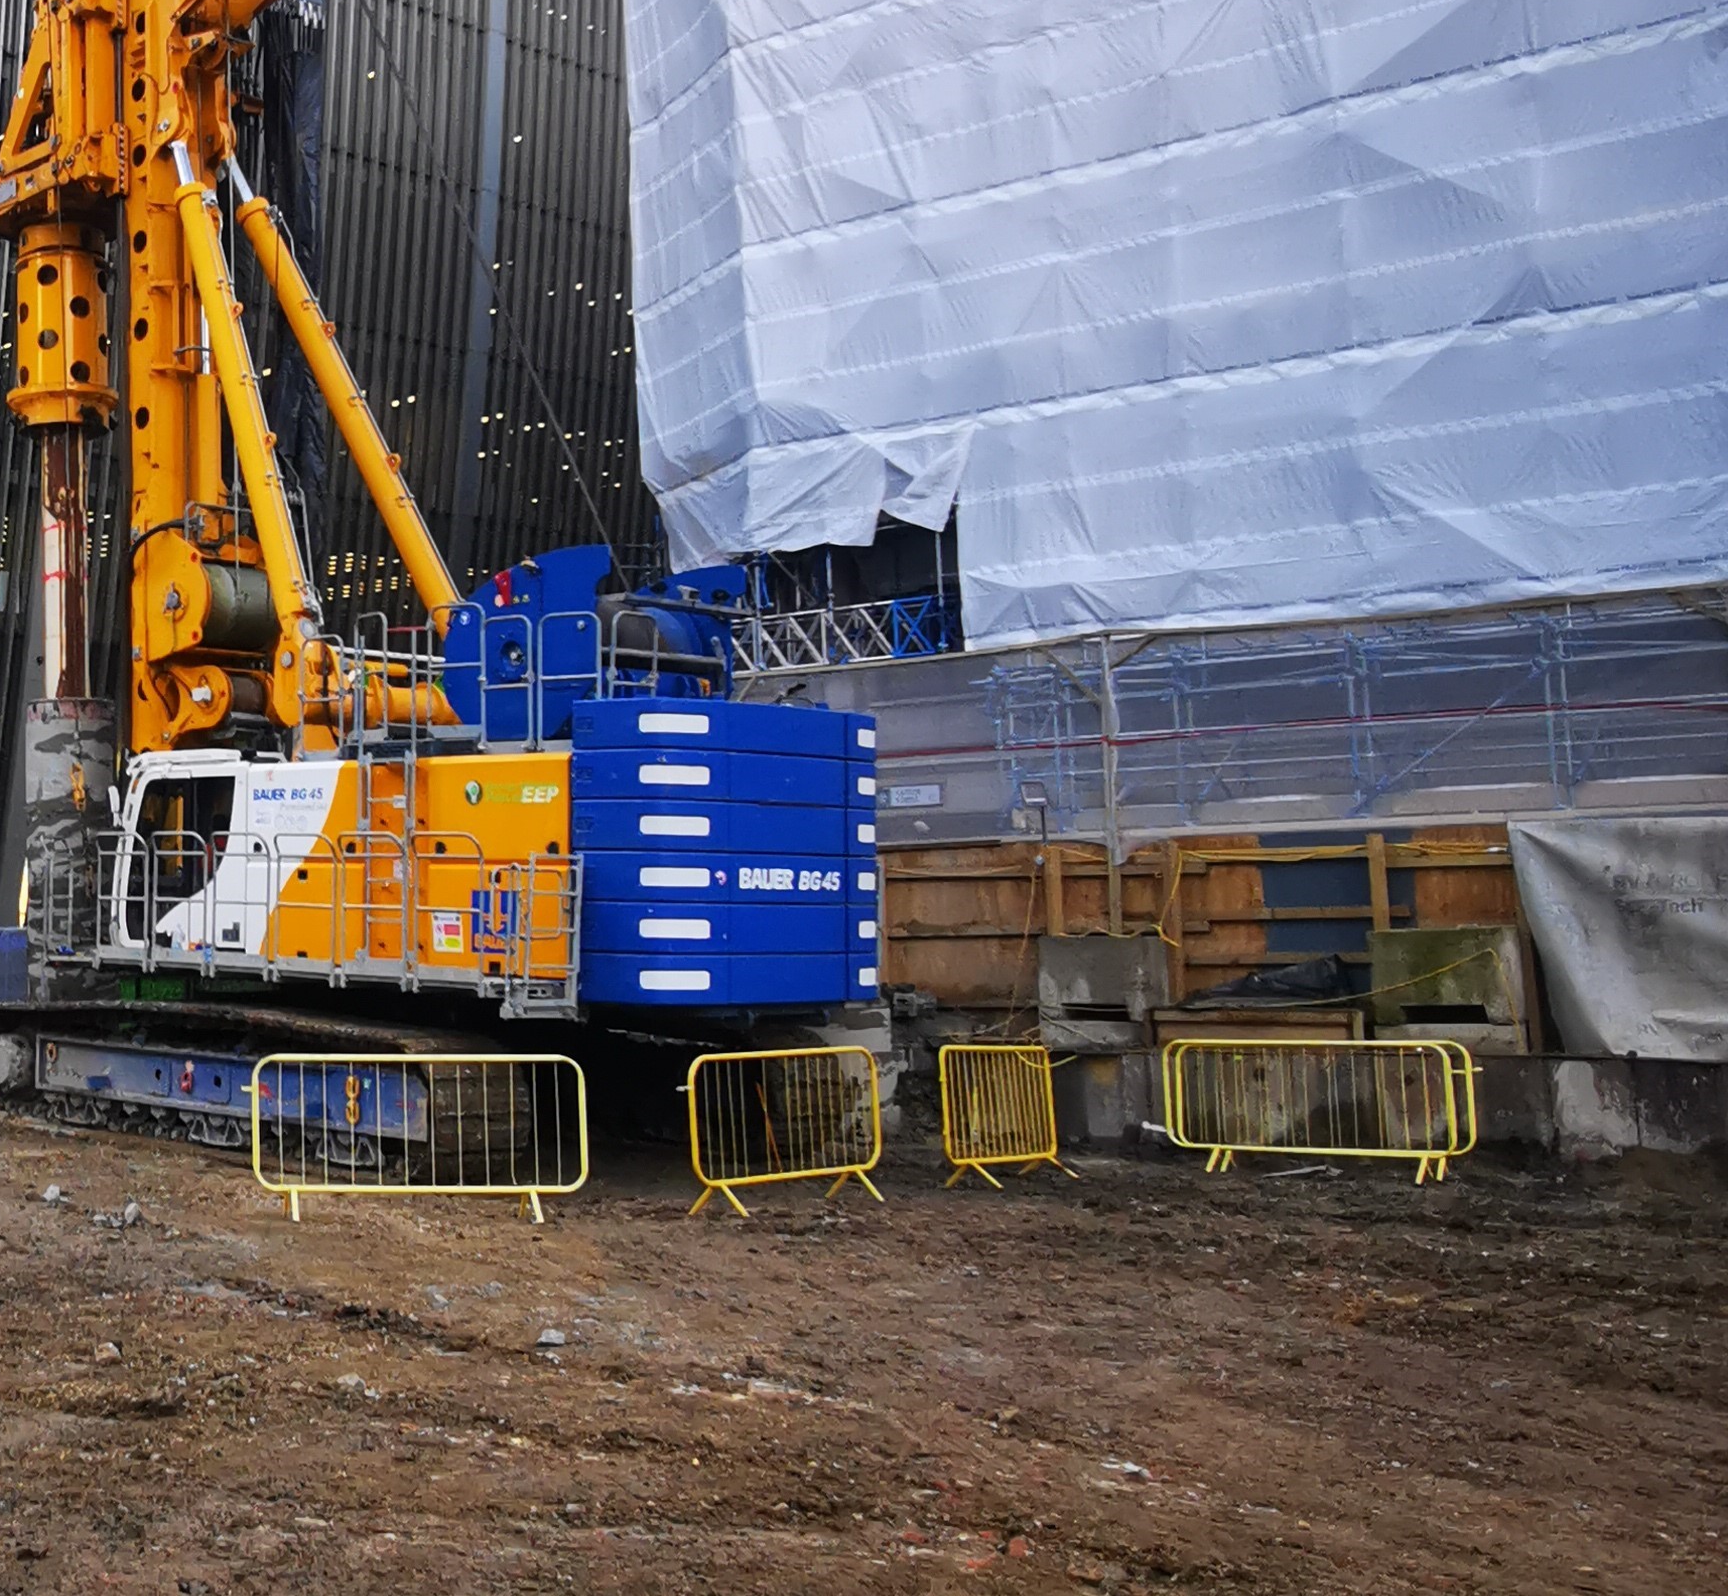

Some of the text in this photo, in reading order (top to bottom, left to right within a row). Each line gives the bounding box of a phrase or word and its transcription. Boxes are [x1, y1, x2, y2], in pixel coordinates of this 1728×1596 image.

[253, 788, 286, 801] BAUER
[521, 785, 559, 803] EEP
[739, 868, 793, 889] BAUER
